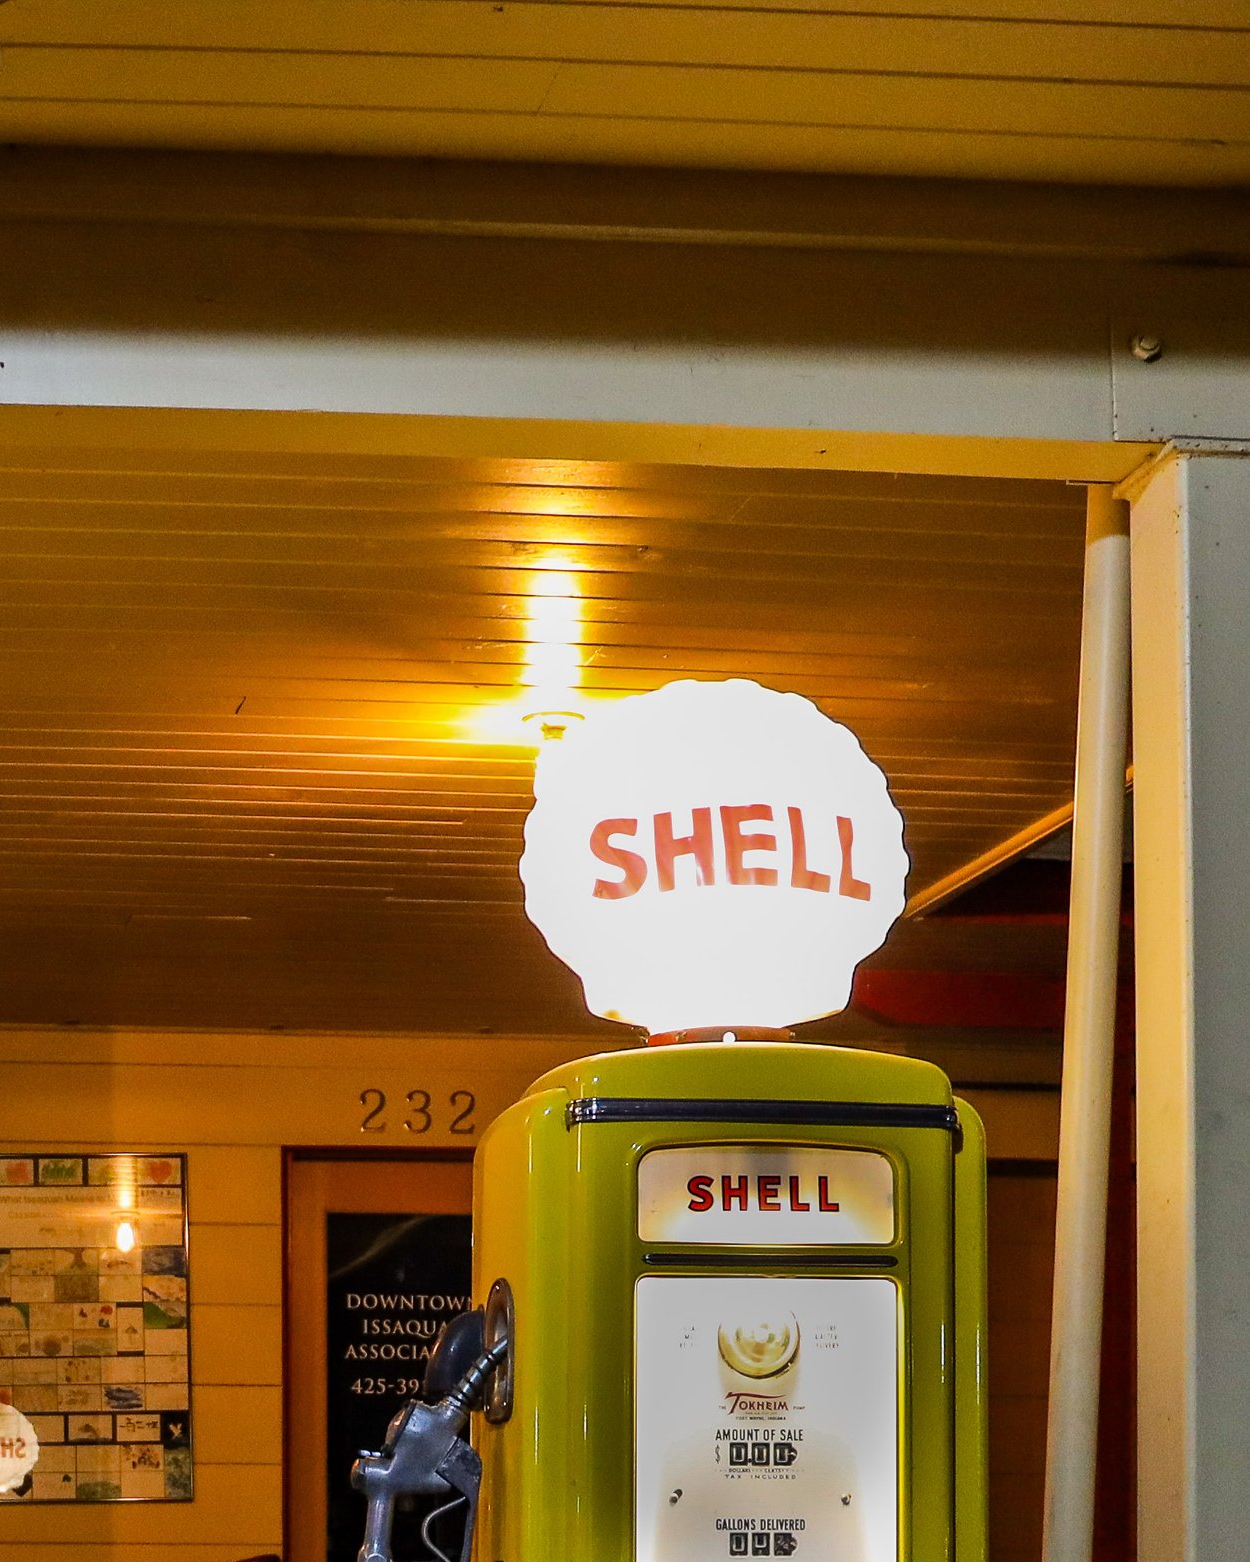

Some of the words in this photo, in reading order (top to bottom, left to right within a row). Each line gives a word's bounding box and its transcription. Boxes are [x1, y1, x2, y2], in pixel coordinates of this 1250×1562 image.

[589, 803, 871, 902] SHELL
[358, 1088, 476, 1135] 232
[687, 1175, 840, 1212] SHELL
[362, 1318, 448, 1338] ISSAQUA
[344, 1343, 431, 1360] ASSOCIA
[351, 1377, 421, 1395] 425-39
[724, 1391, 789, 1416] TOKHEIM
[715, 1428, 760, 1441] AMOUNT
[763, 1428, 776, 1441] OF
[780, 1428, 804, 1441] SALE
[715, 1518, 756, 1531] GALLONS
[760, 1518, 806, 1531] DELIVERED
